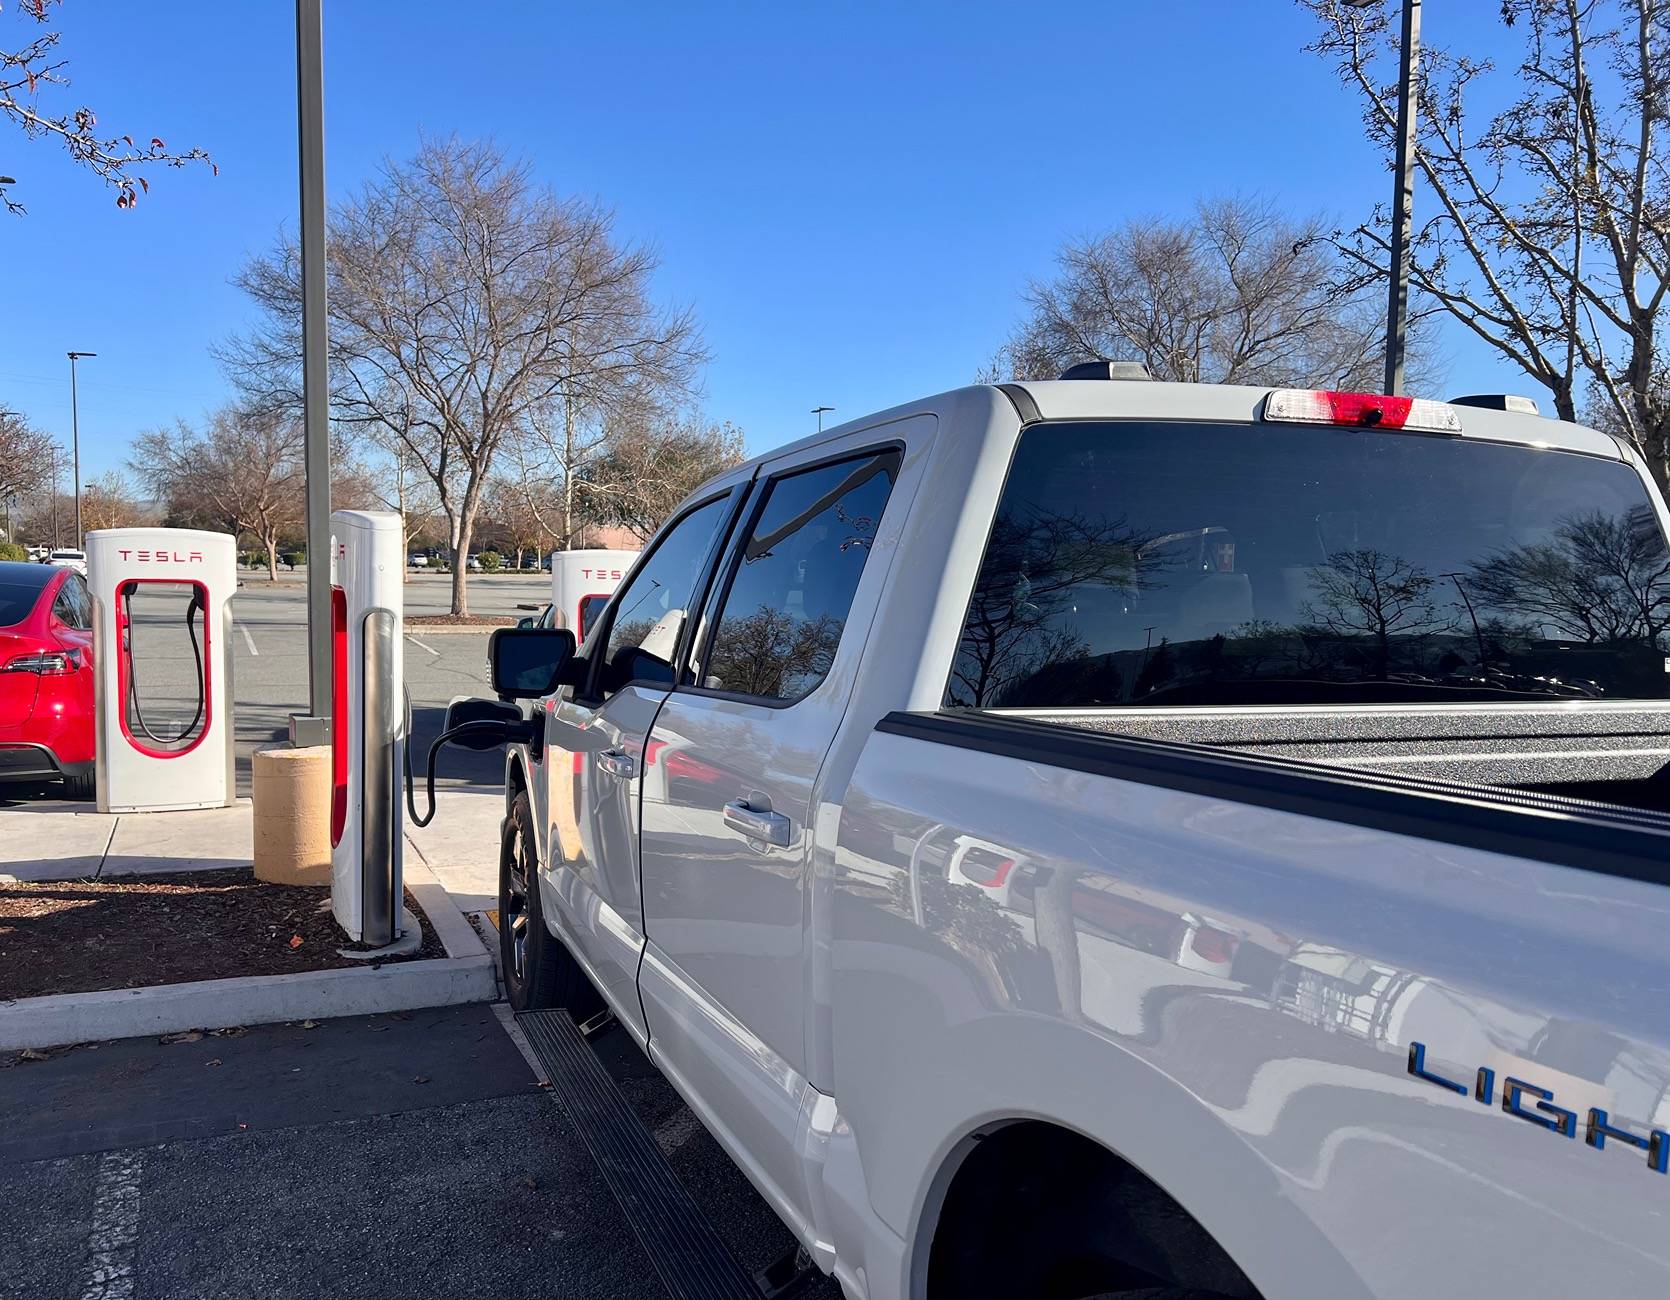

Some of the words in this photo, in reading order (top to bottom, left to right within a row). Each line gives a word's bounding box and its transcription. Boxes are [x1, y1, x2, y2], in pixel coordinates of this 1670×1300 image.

[118, 550, 202, 563] TESLA
[581, 569, 627, 580] TES
[1407, 1041, 1670, 1175] LIGH
